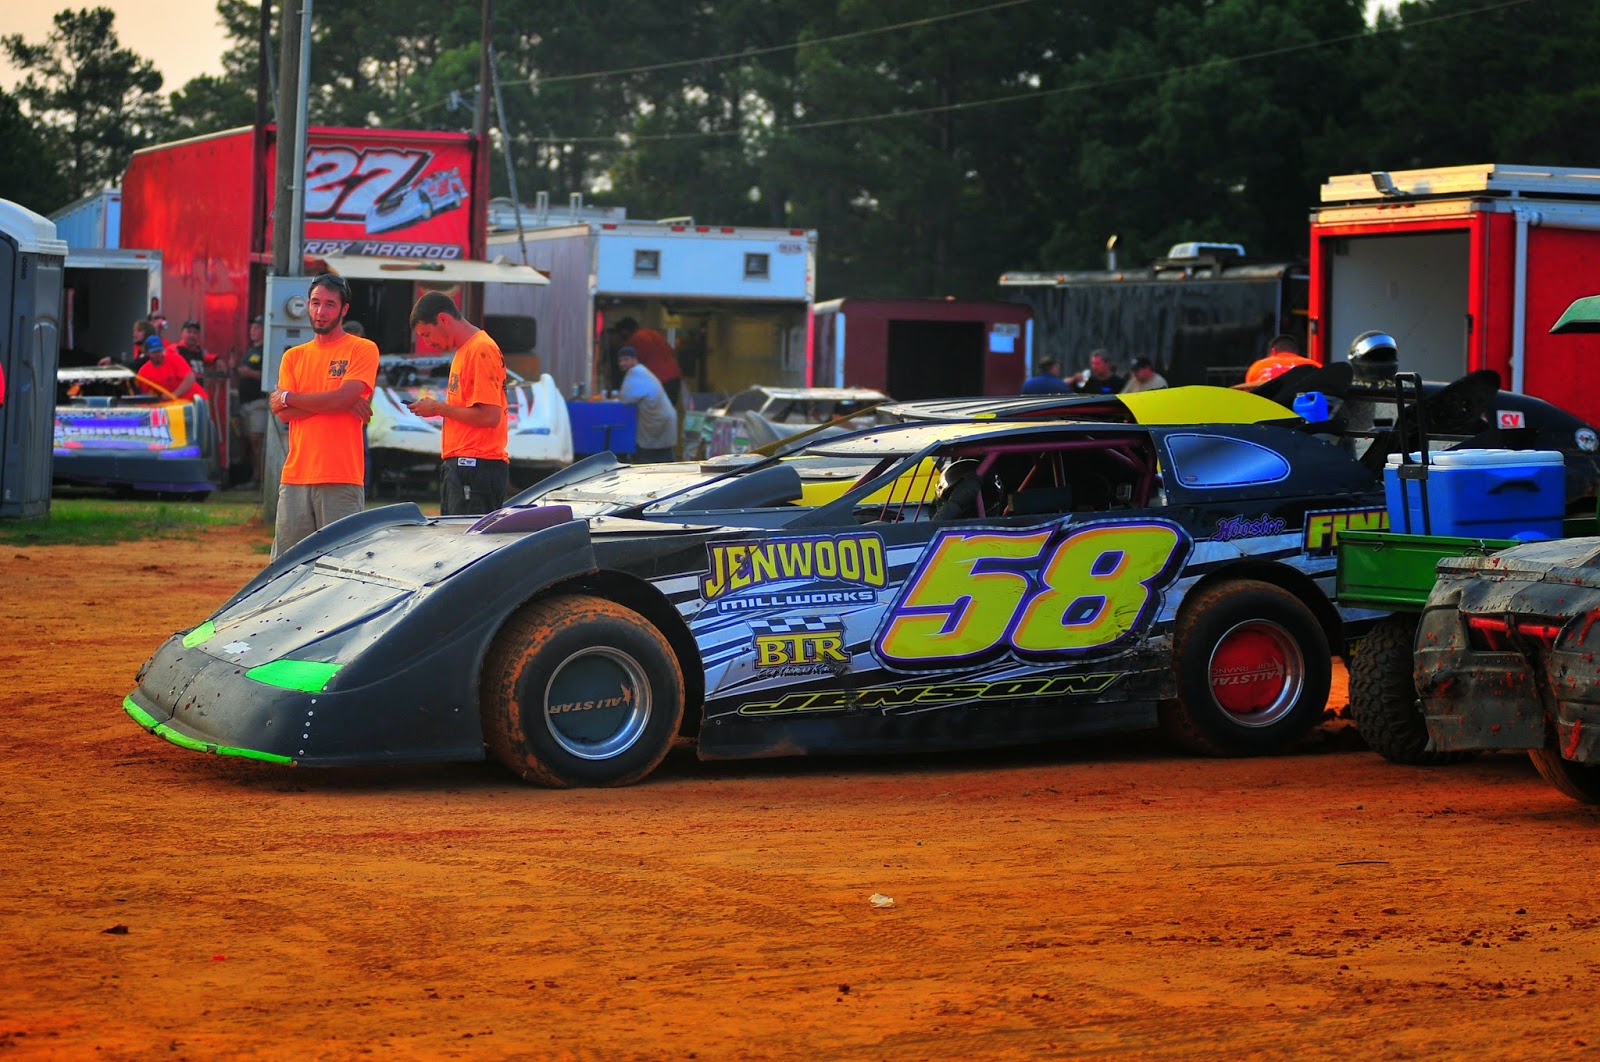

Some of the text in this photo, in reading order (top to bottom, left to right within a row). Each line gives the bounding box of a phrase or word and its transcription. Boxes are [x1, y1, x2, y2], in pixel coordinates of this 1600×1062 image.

[304, 147, 433, 224] 27
[303, 241, 462, 259] RRY HARROD
[1501, 413, 1519, 426] CV
[1211, 515, 1286, 541] Hoosier
[704, 538, 886, 598] JENWOOD
[721, 591, 874, 611] MILLWORKS
[880, 524, 1180, 660] 58
[755, 631, 848, 667] BTR
[736, 673, 1121, 715] JENSON
